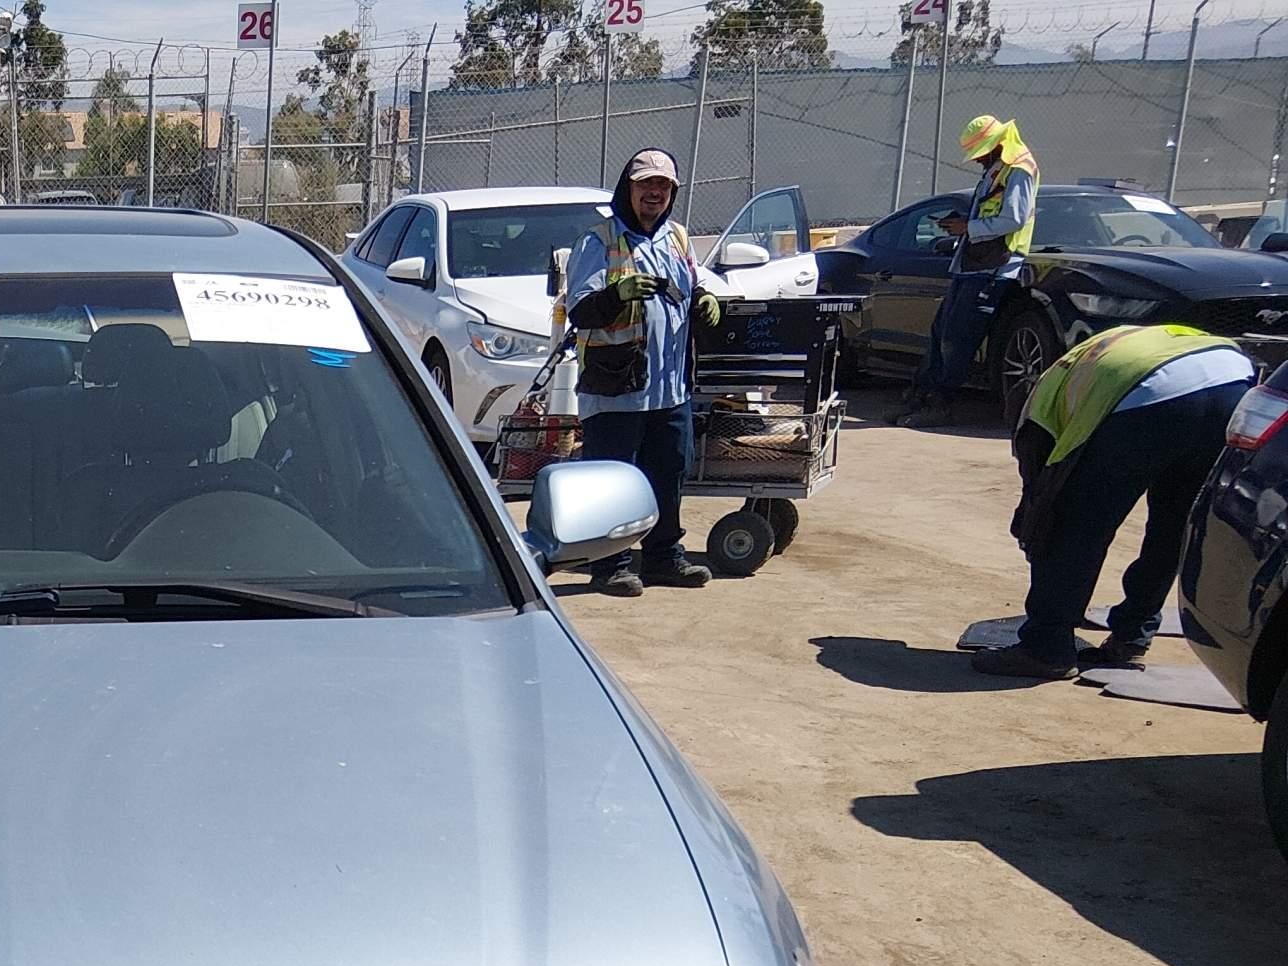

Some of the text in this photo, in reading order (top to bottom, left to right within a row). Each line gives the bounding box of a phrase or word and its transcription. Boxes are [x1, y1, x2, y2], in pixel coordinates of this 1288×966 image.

[607, 0, 642, 24] 25
[240, 11, 273, 40] 26
[196, 289, 331, 310] 45690298
